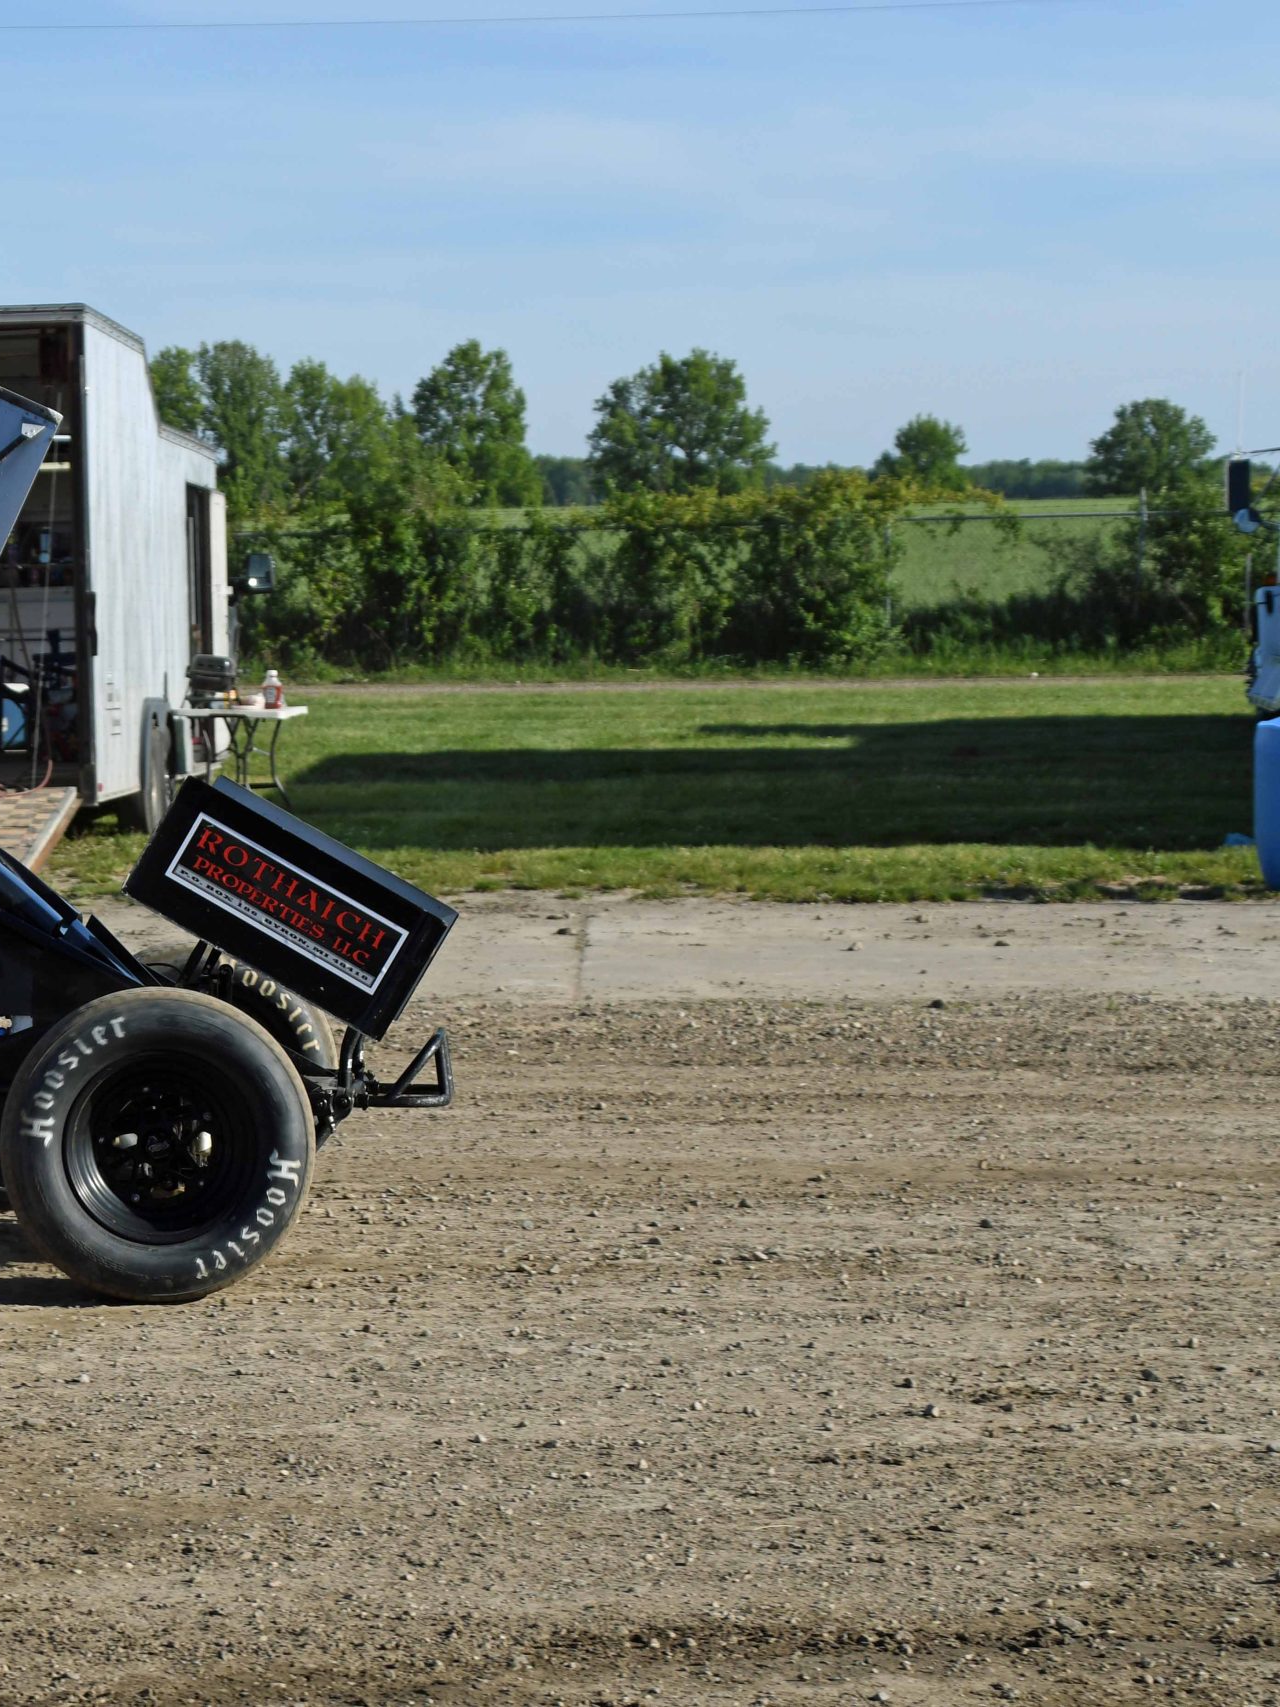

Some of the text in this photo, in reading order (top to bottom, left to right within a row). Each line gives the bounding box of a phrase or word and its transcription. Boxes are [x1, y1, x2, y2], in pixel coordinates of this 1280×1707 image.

[179, 870, 202, 885] P.O.
[205, 884, 233, 901] BOX
[312, 946, 329, 958] MI
[196, 827, 386, 950] ROTHAICH
[332, 937, 370, 966] LLC
